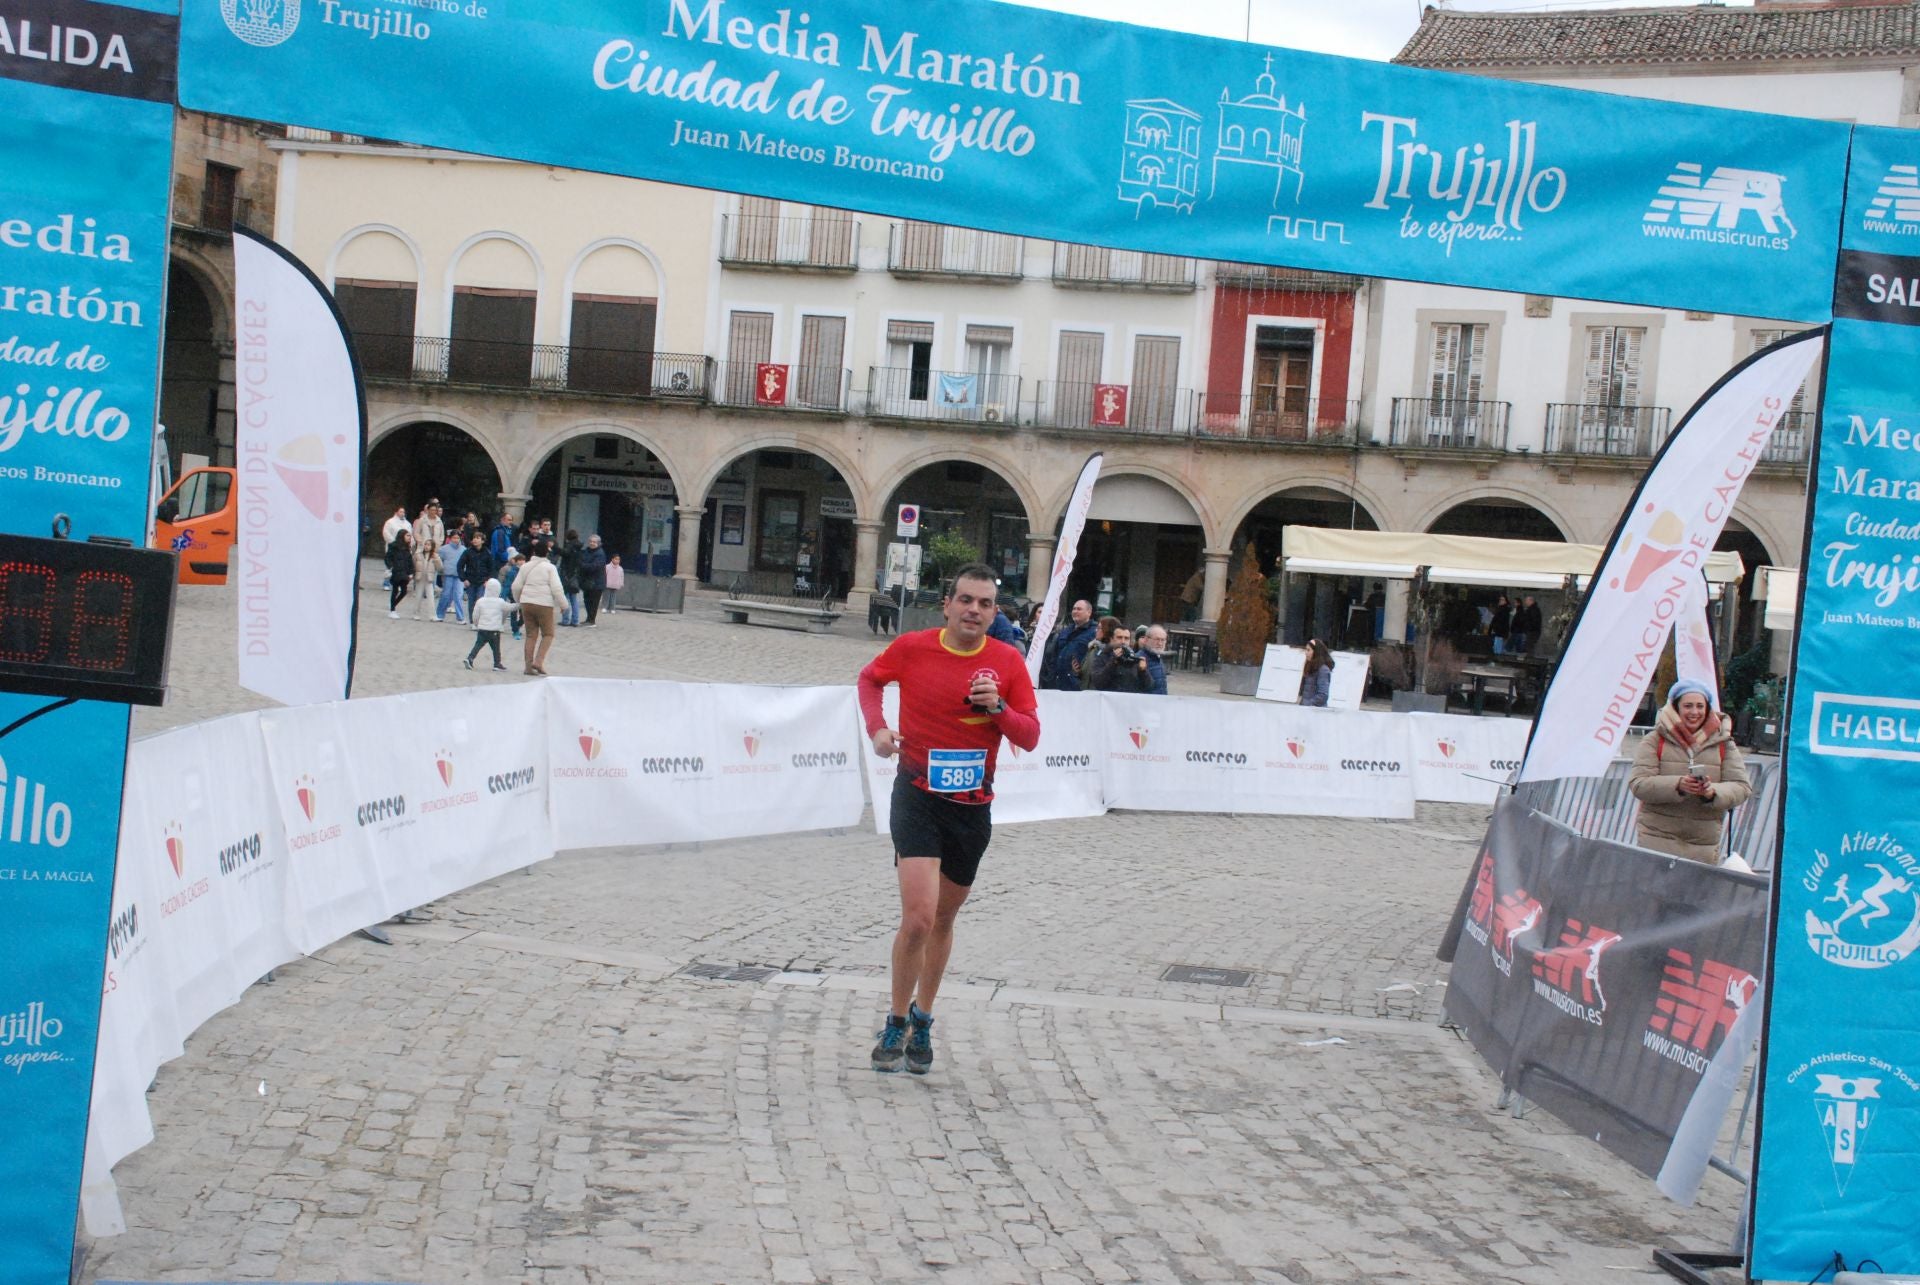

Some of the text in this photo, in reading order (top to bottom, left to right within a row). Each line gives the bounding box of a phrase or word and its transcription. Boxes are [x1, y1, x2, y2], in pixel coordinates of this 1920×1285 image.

[318, 0, 431, 40] Trujillo
[465, 0, 487, 19] de
[662, 0, 1082, 105] Media Maratón
[593, 39, 1036, 163] Ciudad de Trujillo
[670, 119, 944, 183] Juan Mateos Broncano
[1361, 110, 1567, 231] Trujillo
[1400, 203, 1424, 239] te
[1863, 219, 1920, 236] www.m
[1642, 222, 1789, 250] www.musicrun.es
[65, 345, 110, 372] de
[34, 466, 122, 488] Broncano
[1822, 610, 1853, 625] Juan
[1856, 612, 1905, 627] Mateos
[1594, 576, 1687, 746] DIPUTACIÓN
[1680, 533, 1709, 568] DE
[941, 768, 975, 786] 589
[23, 869, 39, 881] LA
[45, 871, 94, 882] MAGIA
[1803, 830, 1920, 892] Club Atletismo
[1812, 933, 1900, 963] TRUJILLO
[1787, 1052, 1920, 1091] Club Athletico San José
[1823, 1104, 1868, 1129] A J
[1840, 1129, 1850, 1150] S
